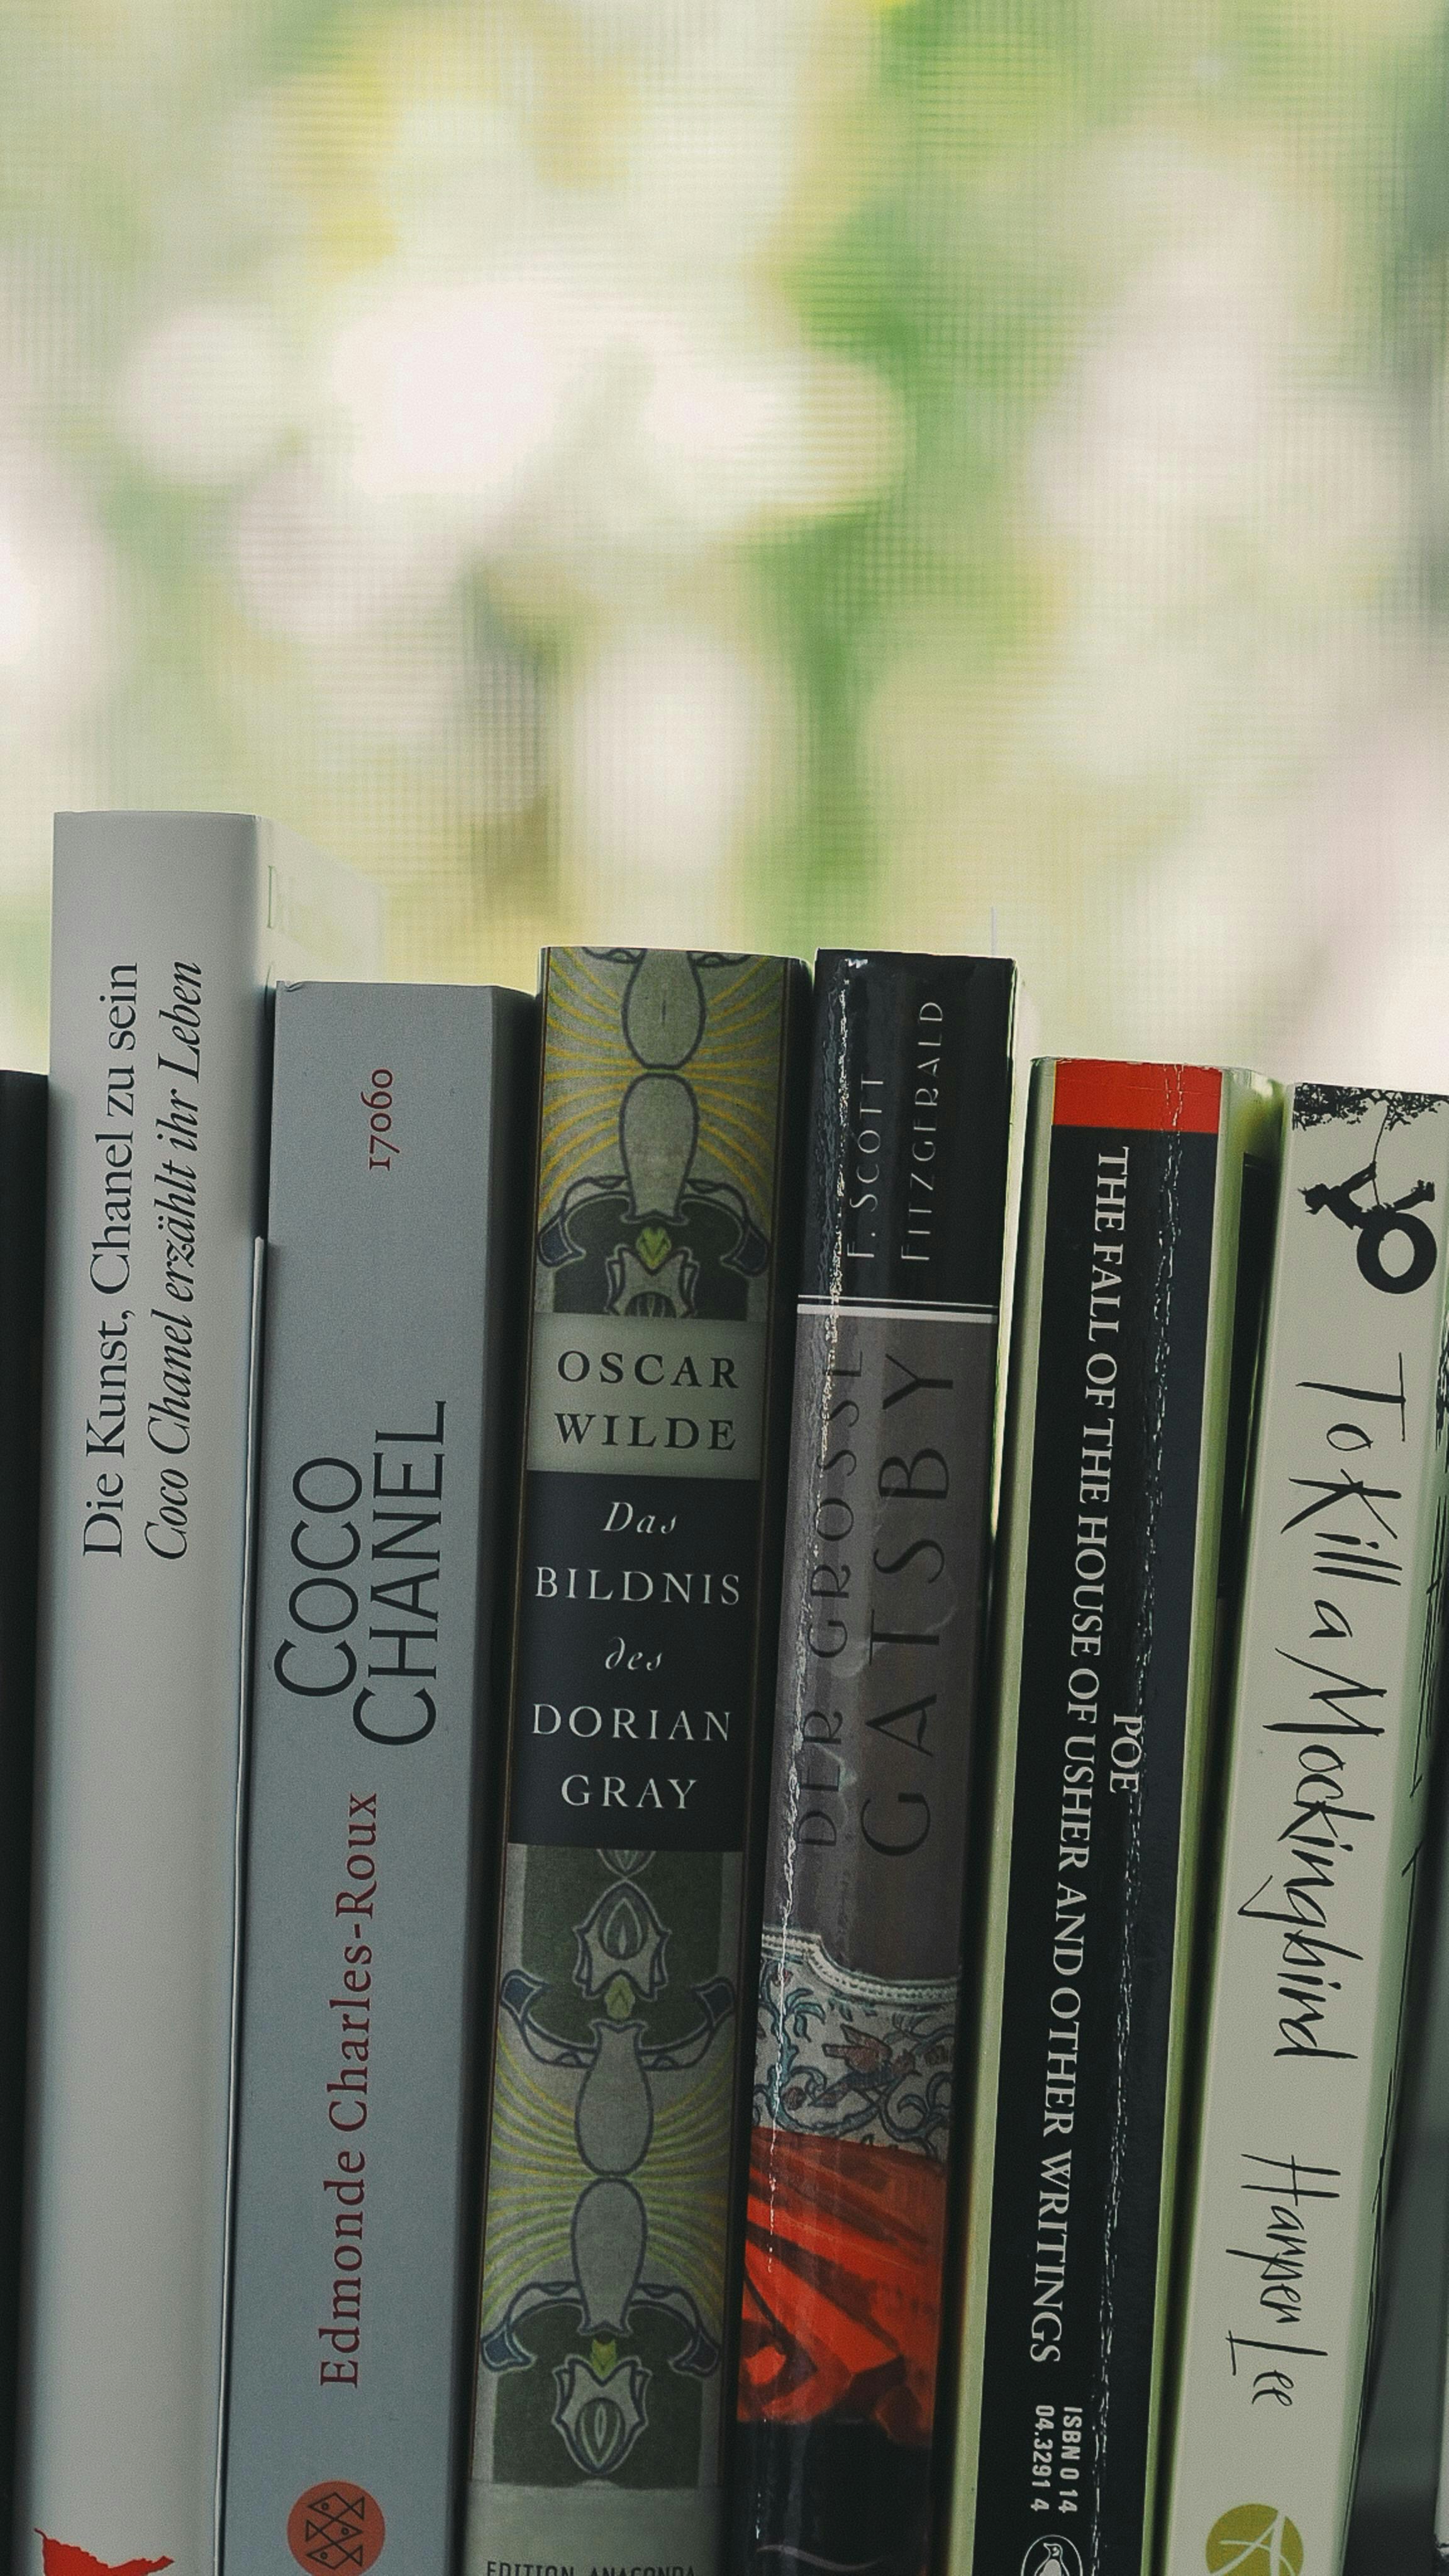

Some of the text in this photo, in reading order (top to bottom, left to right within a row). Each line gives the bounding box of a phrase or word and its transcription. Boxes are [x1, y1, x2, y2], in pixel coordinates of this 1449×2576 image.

[361, 1069, 400, 1170] 17060
[850, 1074, 884, 1213] SCOTT
[901, 1002, 943, 1261] FITZGERALD
[84, 963, 137, 1557] Die Kunst, Chanel zu sein
[145, 962, 202, 1560] Coco Chanel erzählt ihr Leben
[555, 1413, 736, 1451] WILDE
[558, 1350, 738, 1389] OSCAR
[274, 1458, 362, 1697] COCO
[353, 1401, 446, 1745] CHANEL
[536, 1567, 740, 1605] BILDNIS
[603, 1502, 678, 1535] Das
[605, 1637, 662, 1671] des
[861, 1353, 953, 1857] GATSBY
[533, 1704, 730, 1741] DORIAN
[1030, 1146, 1129, 2363] THE FALL OF THE HOUSE OF USHER AND OTHER WRITINGS
[1109, 1714, 1142, 1794] POE
[1237, 1352, 1406, 2059] To Kill a Mockingbird
[561, 1774, 697, 1809] GRAY
[798, 1711, 843, 1846] DER
[319, 1792, 377, 2389] Edmonde Charles-Roux
[1225, 2153, 1340, 2406] Harper Lee
[1031, 2406, 1055, 2511] 04.3291 4
[1058, 2407, 1082, 2513] ISBN 0 14
